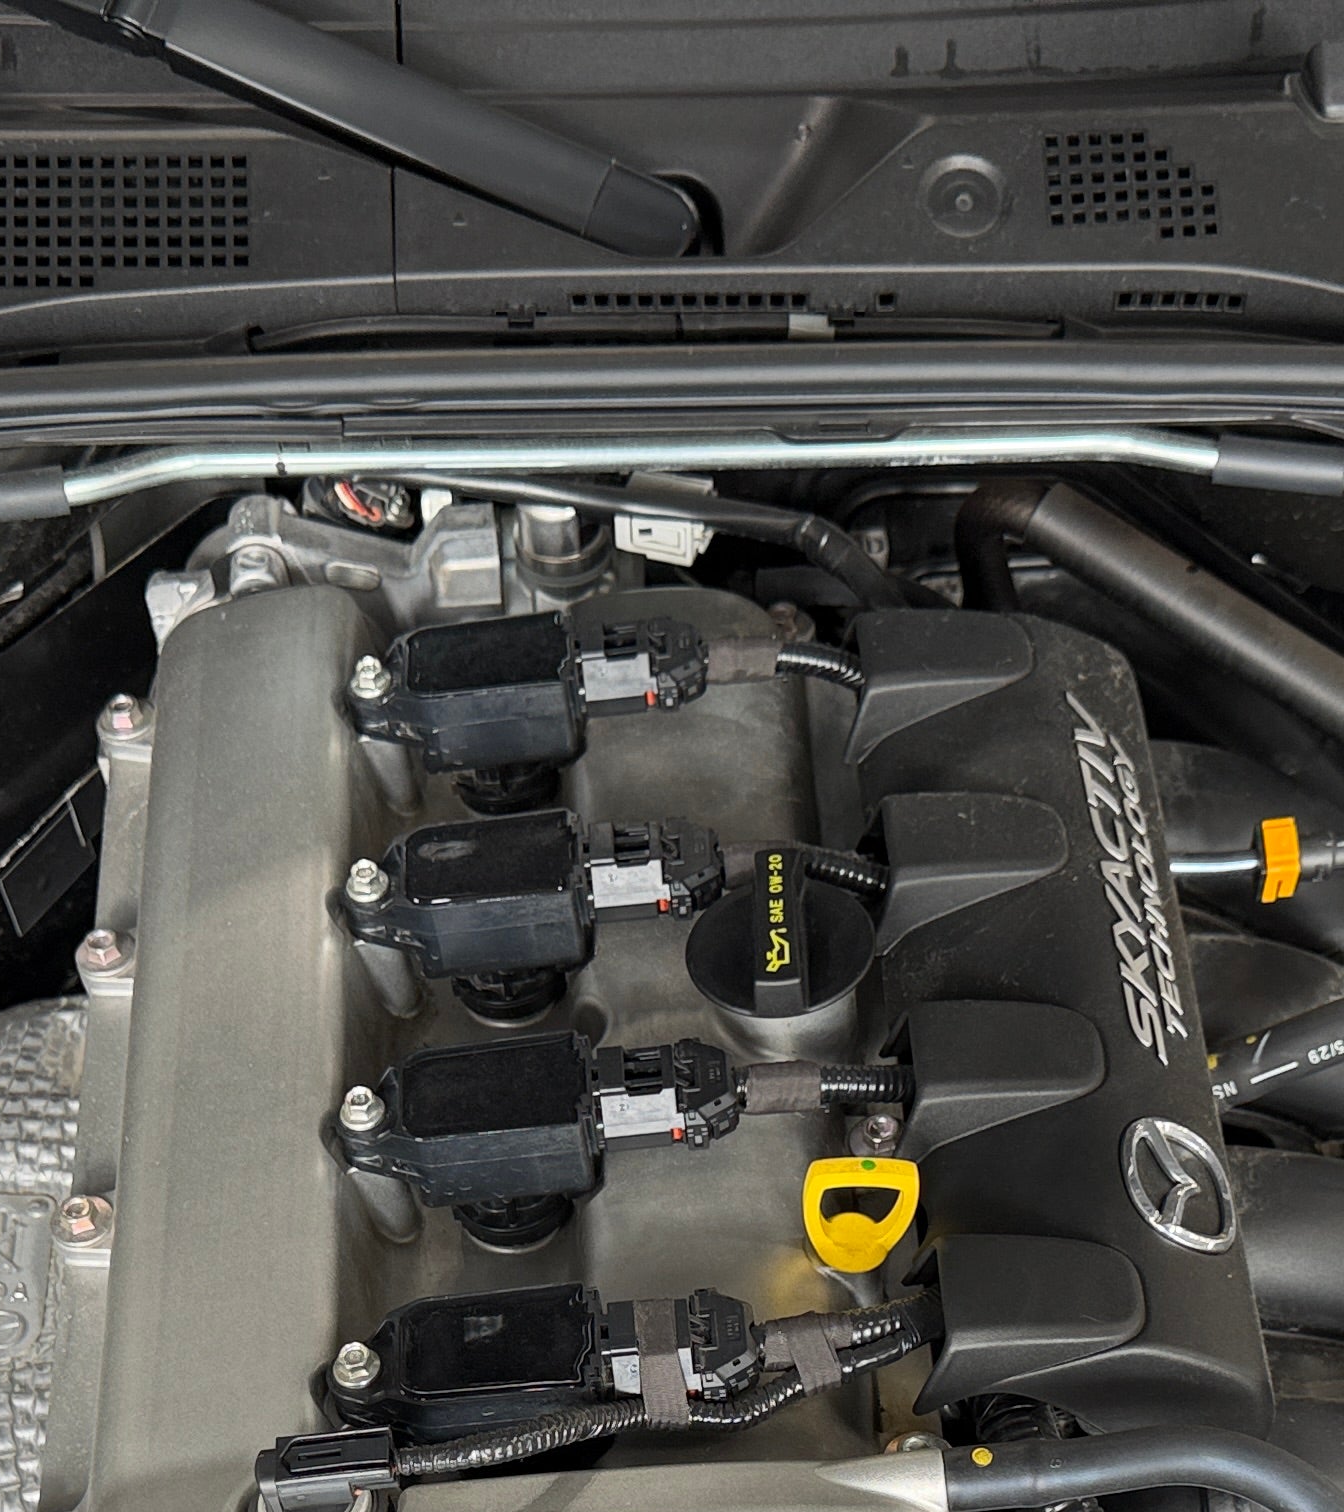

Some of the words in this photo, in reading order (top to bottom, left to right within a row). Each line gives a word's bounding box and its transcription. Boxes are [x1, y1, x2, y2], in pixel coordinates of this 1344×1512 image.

[765, 853, 786, 894] 0W-20
[767, 897, 785, 923] SAE
[1066, 692, 1167, 1067] SKYACTIV
[1111, 734, 1187, 1038] TECHNOLOGY
